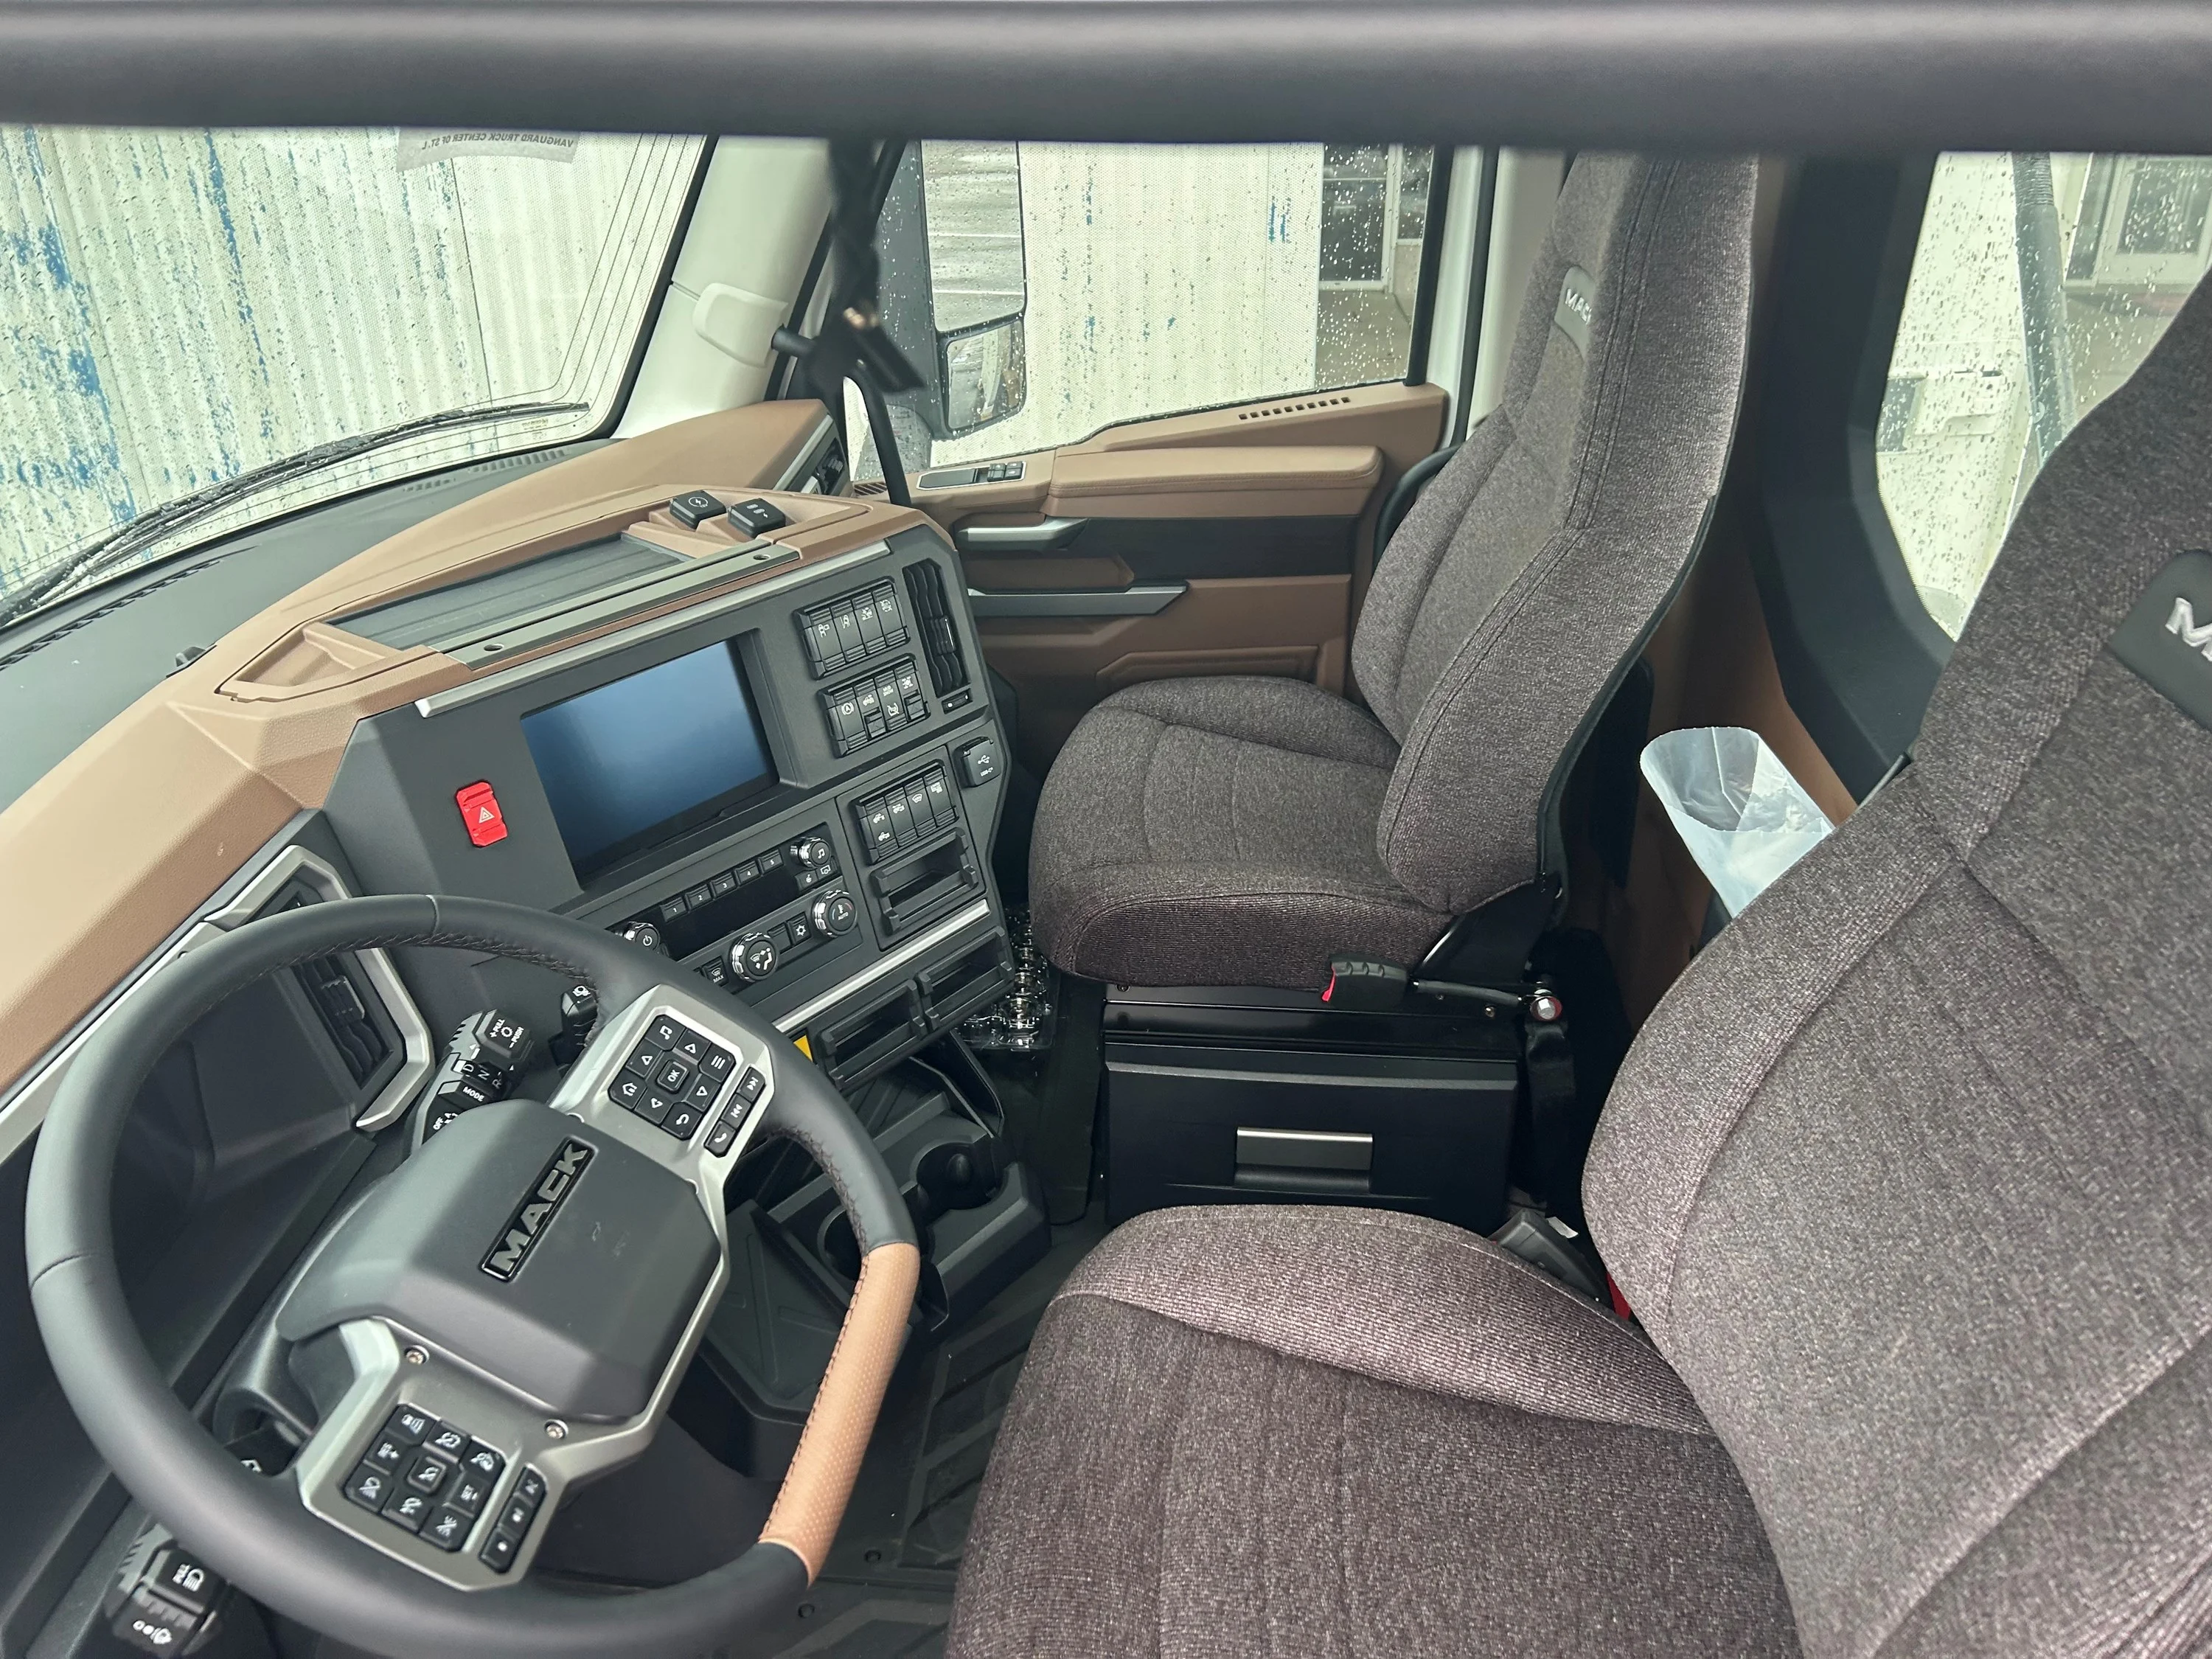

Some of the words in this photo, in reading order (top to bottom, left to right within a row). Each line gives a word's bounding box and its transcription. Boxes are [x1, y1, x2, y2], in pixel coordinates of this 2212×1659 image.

[462, 1063, 474, 1073] D
[667, 1069, 681, 1082] OK
[462, 1086, 485, 1102] MODE
[490, 1144, 588, 1272] MACK
